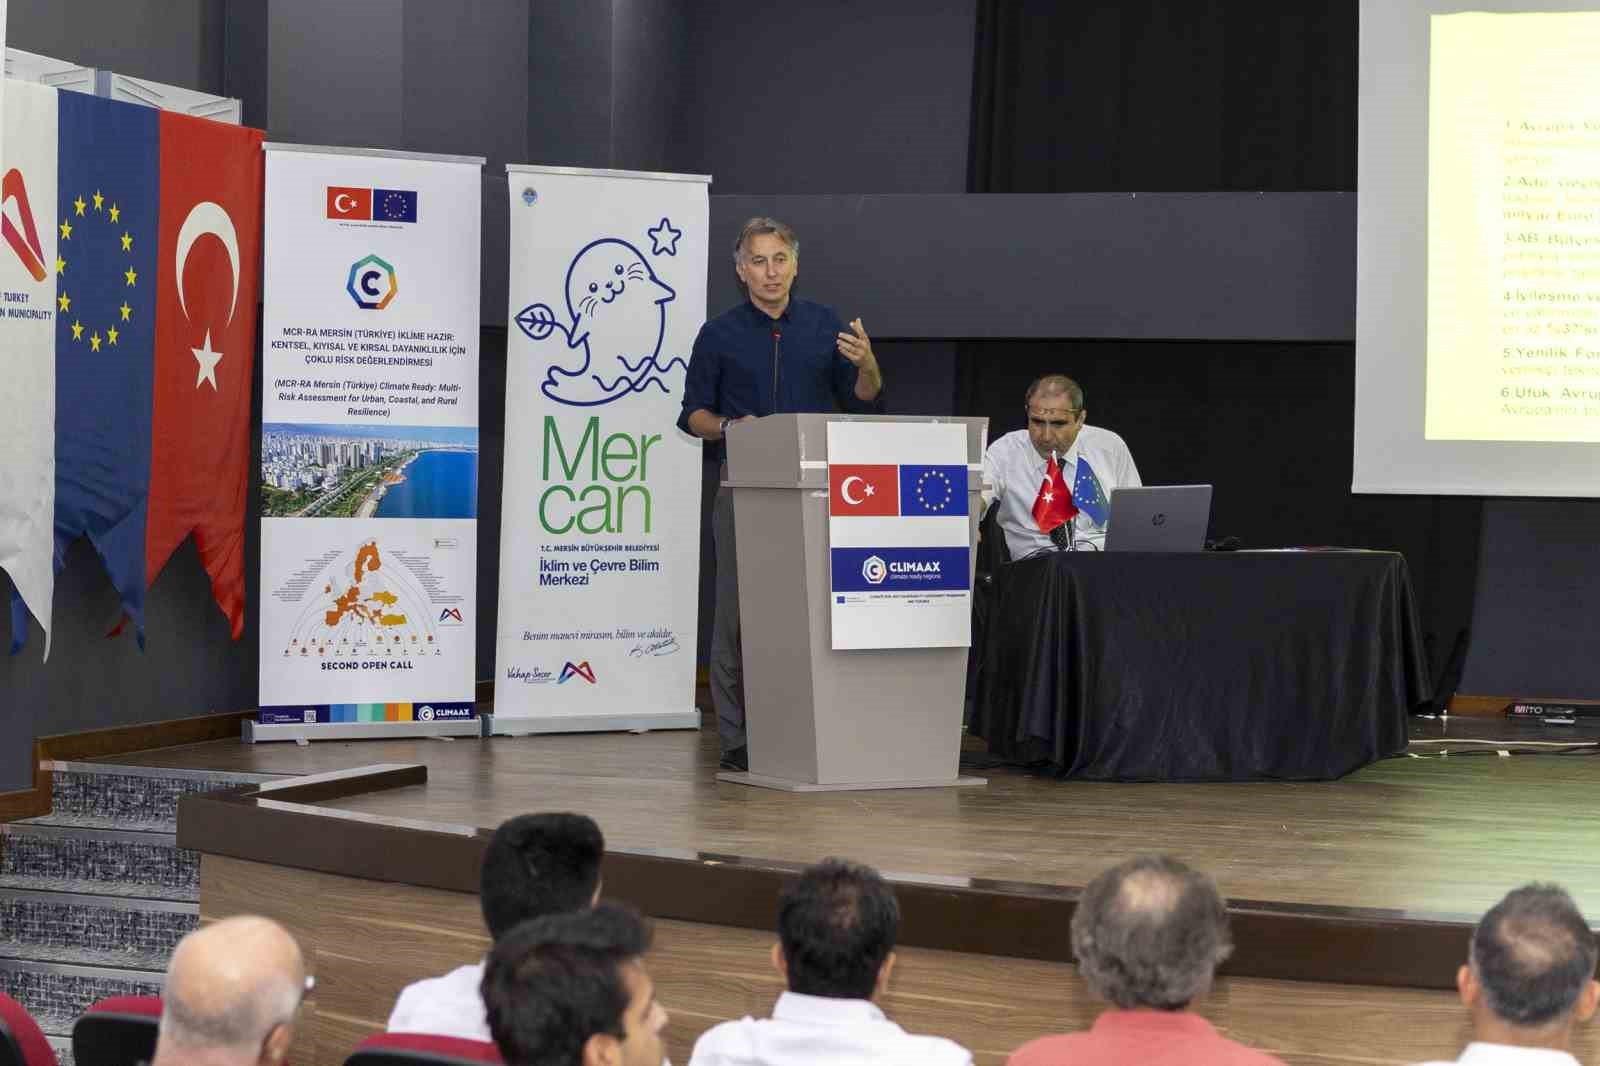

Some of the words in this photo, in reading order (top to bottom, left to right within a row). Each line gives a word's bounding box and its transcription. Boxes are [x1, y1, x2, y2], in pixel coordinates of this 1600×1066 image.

[3, 292, 29, 303] TURKEY
[8, 308, 52, 320] MUNICIPALITY
[283, 327, 318, 337] MCR-RA
[319, 328, 353, 338] MERSİN
[354, 329, 396, 340] (TÜRKİYE)
[313, 341, 346, 351] KIYISAL
[347, 343, 360, 352] VE
[360, 343, 391, 353] KIRSAL
[392, 344, 448, 354] DAYANIKLILIK
[304, 354, 334, 365] ÇOKLU
[335, 355, 355, 366] RİSK
[356, 355, 433, 367] DEĞERLENDİRMESİ
[274, 378, 312, 389] (MCR-RA
[313, 380, 341, 390] Mersin
[380, 381, 410, 391] Climate
[278, 392, 296, 401] Risk
[297, 393, 347, 402] Assessment
[347, 394, 361, 403] for
[421, 396, 436, 405] and
[437, 396, 458, 406] Rural
[347, 407, 391, 418] Resilience)
[542, 415, 662, 482] Mer
[539, 484, 652, 535] can
[539, 556, 570, 572] İklim
[572, 561, 588, 572] ve
[590, 558, 627, 575] Çevre
[629, 558, 660, 572] Bilim
[889, 561, 941, 573] CLIMAAX
[539, 573, 589, 586] Merkezi
[523, 631, 549, 641] Benim
[549, 631, 579, 641] manevi
[615, 629, 636, 640] bilim
[637, 632, 646, 640] ve
[320, 661, 359, 671] SECOND
[361, 661, 388, 670] OPEN
[389, 660, 414, 670] CALL
[435, 708, 470, 717] CLIMAAX
